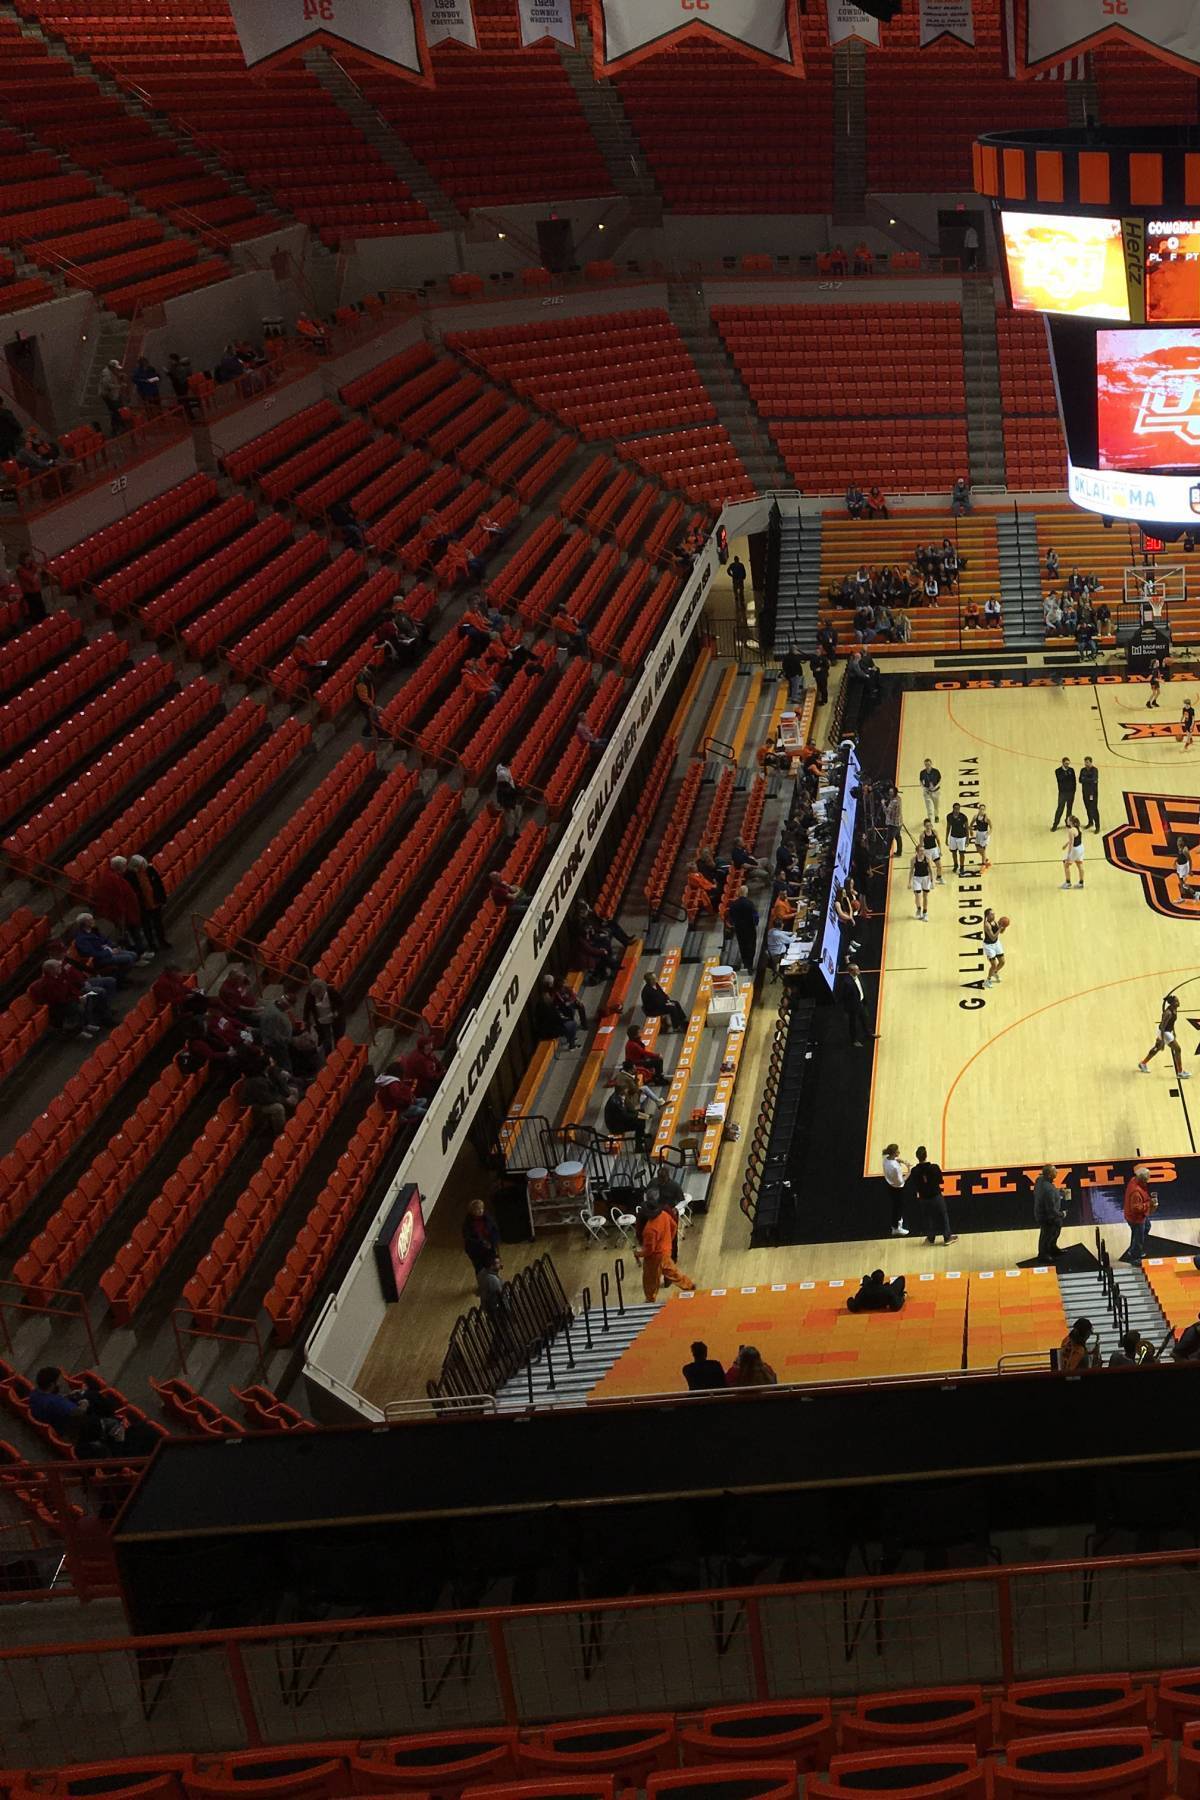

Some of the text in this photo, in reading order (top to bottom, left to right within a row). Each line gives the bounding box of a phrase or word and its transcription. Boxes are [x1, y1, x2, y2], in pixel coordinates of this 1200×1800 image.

[1125, 221, 1142, 285] Hertz
[1167, 237, 1180, 250] 0
[1149, 252, 1200, 261] PL F PT
[111, 475, 128, 494] 213
[934, 672, 1200, 690] OKLAHOMA
[959, 756, 981, 810] ARENA
[441, 1013, 504, 1156] WELCOME
[502, 974, 521, 1019] TO
[533, 837, 586, 960] HISTORIC
